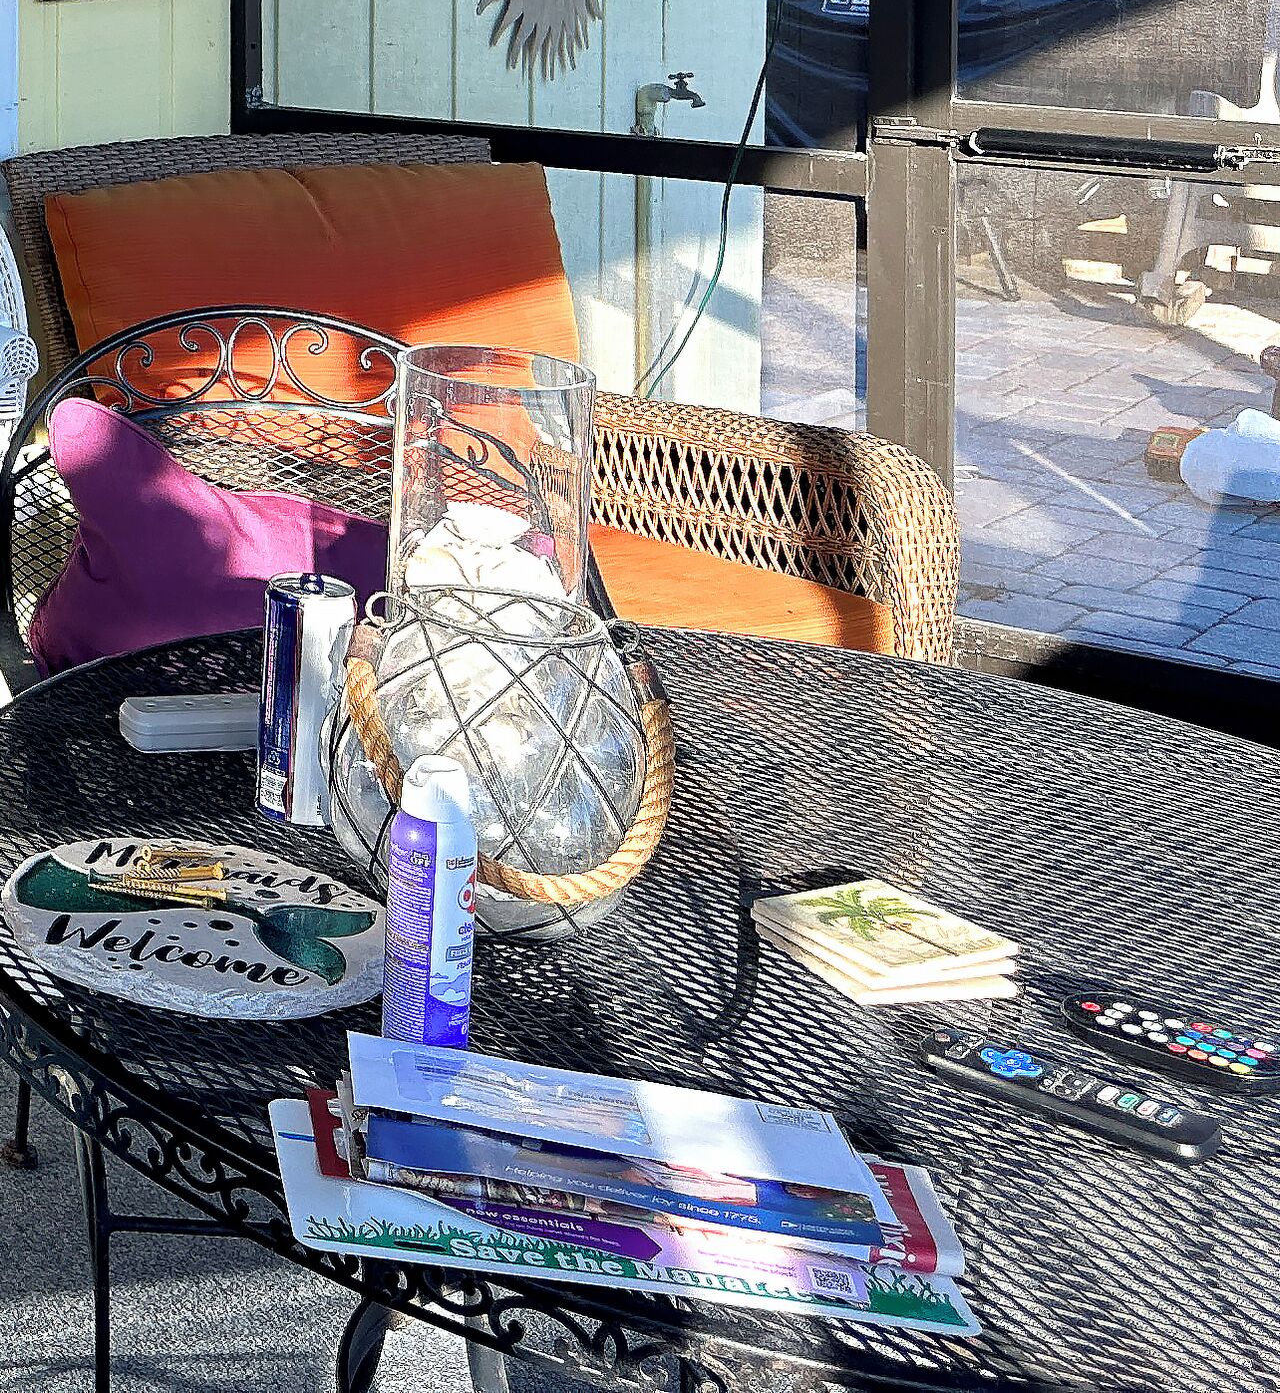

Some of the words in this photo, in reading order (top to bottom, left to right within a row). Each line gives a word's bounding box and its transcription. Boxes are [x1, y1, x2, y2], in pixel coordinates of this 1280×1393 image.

[85, 841, 354, 905] Maids
[45, 914, 310, 986] Welcome
[505, 1165, 562, 1183] Helping
[678, 1201, 720, 1217] since
[448, 1237, 546, 1266] Save
[553, 1251, 625, 1276] the
[633, 1260, 814, 1303] Manat
